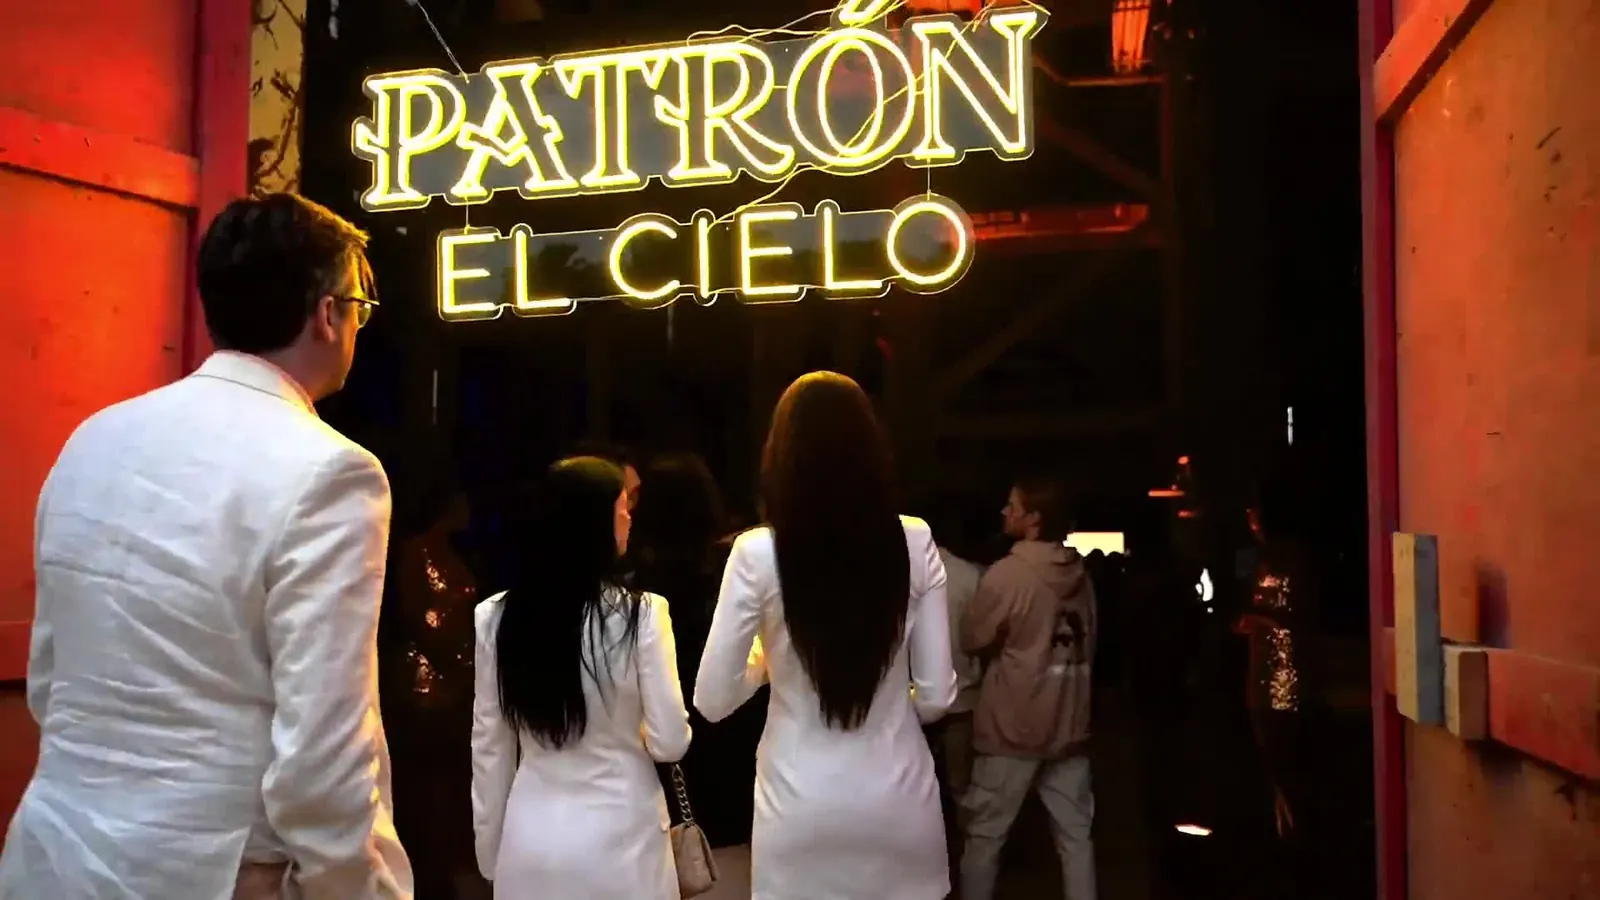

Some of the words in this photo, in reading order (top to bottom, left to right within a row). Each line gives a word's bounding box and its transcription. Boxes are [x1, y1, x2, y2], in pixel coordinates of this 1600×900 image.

[354, 0, 1037, 205] PATRÓN
[441, 230, 570, 313] EL
[609, 202, 967, 300] CIELO
